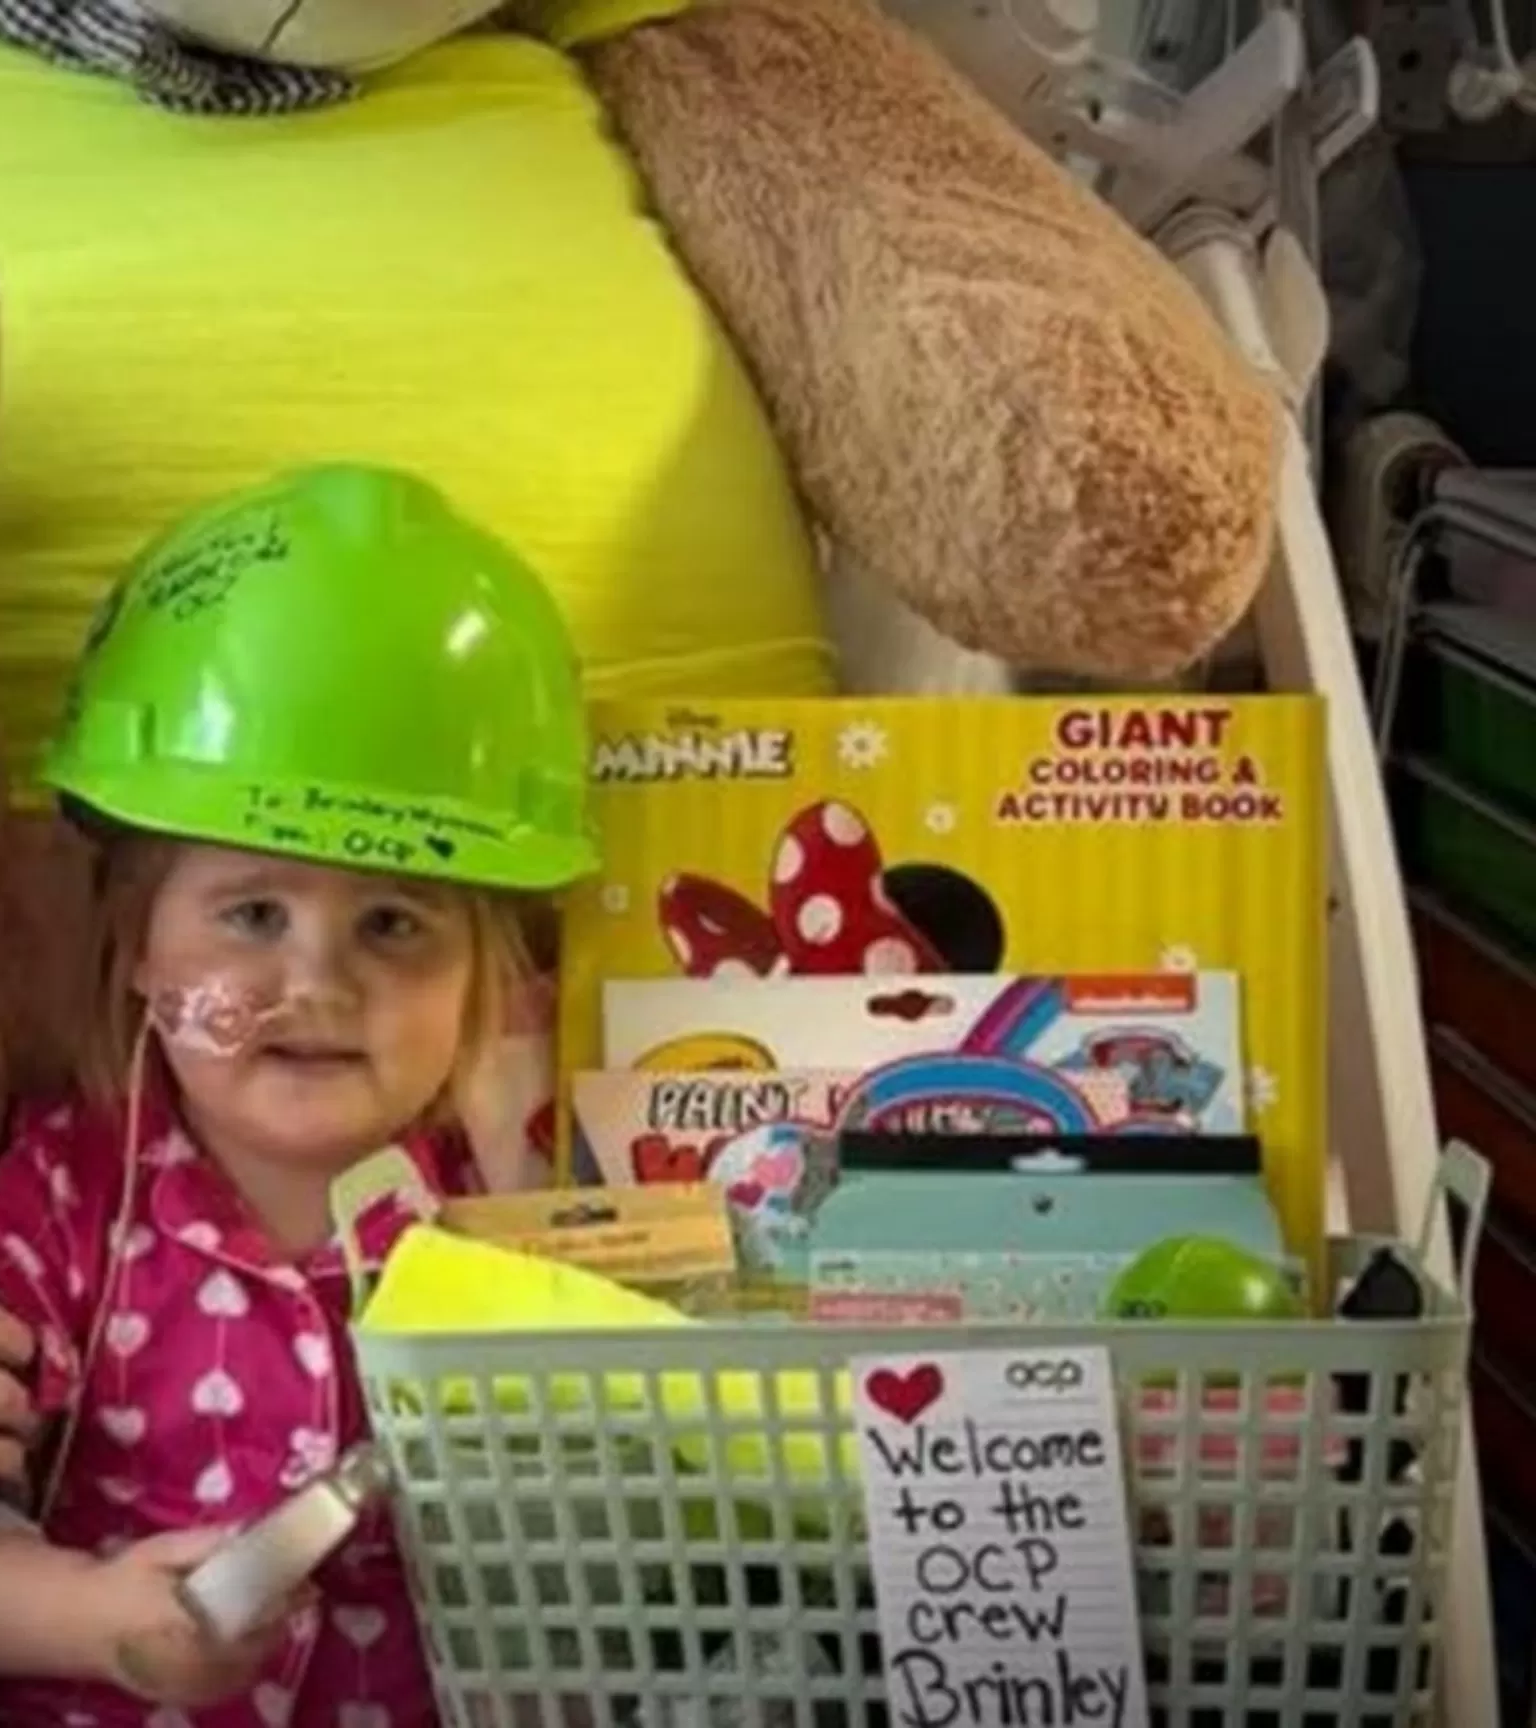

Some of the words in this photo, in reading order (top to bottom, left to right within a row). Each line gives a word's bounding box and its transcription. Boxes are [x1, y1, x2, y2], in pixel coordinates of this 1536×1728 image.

[1057, 707, 1231, 748] GIANT
[592, 729, 794, 782] MINNIE
[1029, 757, 1220, 786] COLORING
[997, 793, 1169, 820] ACTIVITY
[1181, 794, 1283, 820] BOOK
[649, 1079, 811, 1131] PAINT
[868, 1417, 1106, 1476] Welcome
[893, 1487, 966, 1533] to
[992, 1481, 1086, 1533] the
[916, 1537, 1057, 1594] OCP
[907, 1596, 1068, 1644] crew
[892, 1648, 1128, 1728] Brinley
